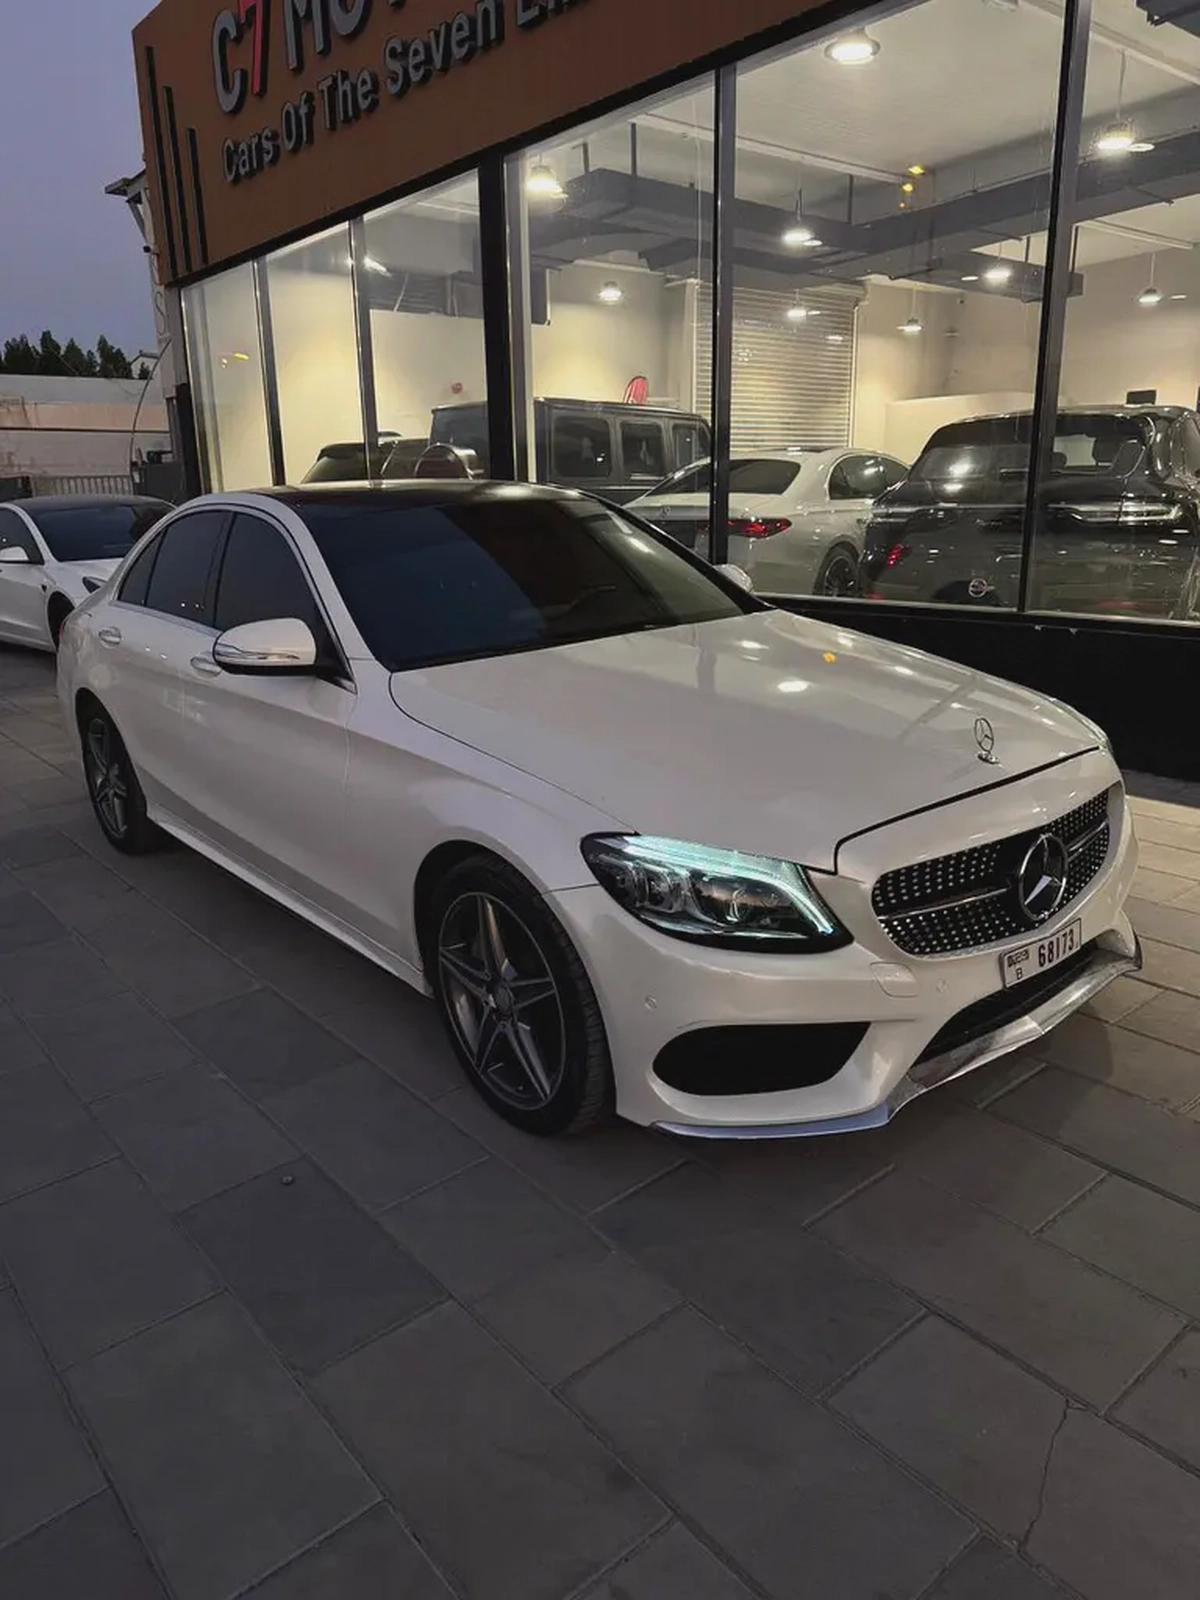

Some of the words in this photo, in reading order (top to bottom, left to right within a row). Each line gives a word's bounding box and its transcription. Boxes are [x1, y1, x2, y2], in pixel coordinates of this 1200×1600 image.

[212, 0, 267, 114] C7
[223, 126, 277, 183] Cars
[281, 91, 313, 152] Of
[318, 69, 377, 130] The
[384, 0, 504, 96] Seven
[1038, 928, 1075, 968] 68173
